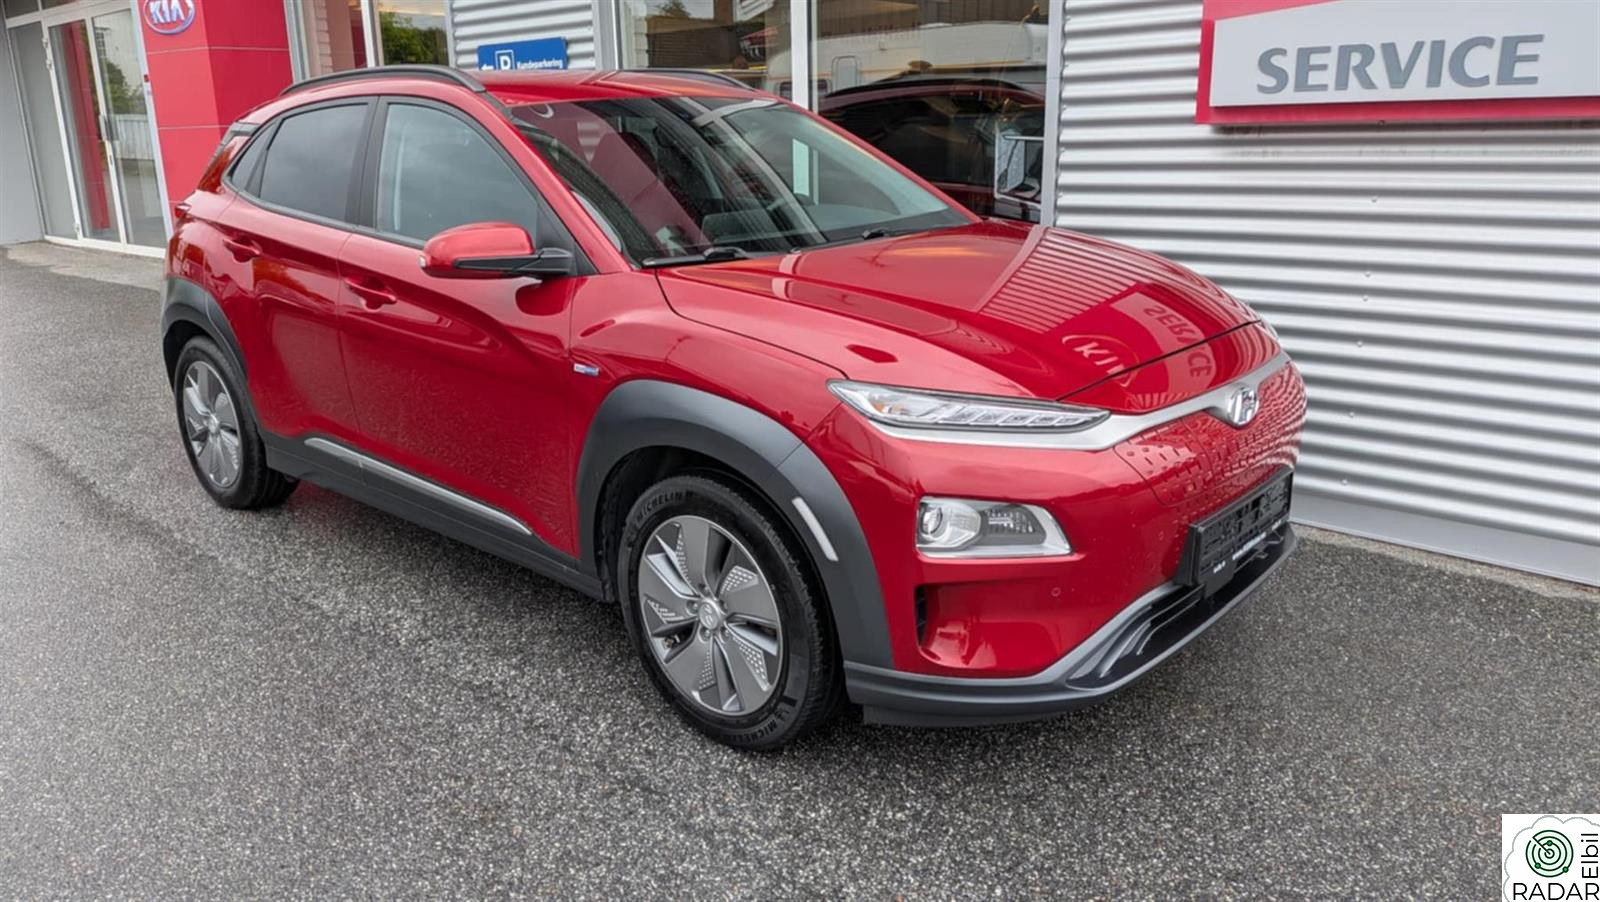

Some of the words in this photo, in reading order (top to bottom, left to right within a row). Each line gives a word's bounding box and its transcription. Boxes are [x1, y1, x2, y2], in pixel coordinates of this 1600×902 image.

[149, 0, 186, 24] KIA
[1257, 33, 1545, 95] SERVICE
[636, 491, 684, 523] MICHELIN
